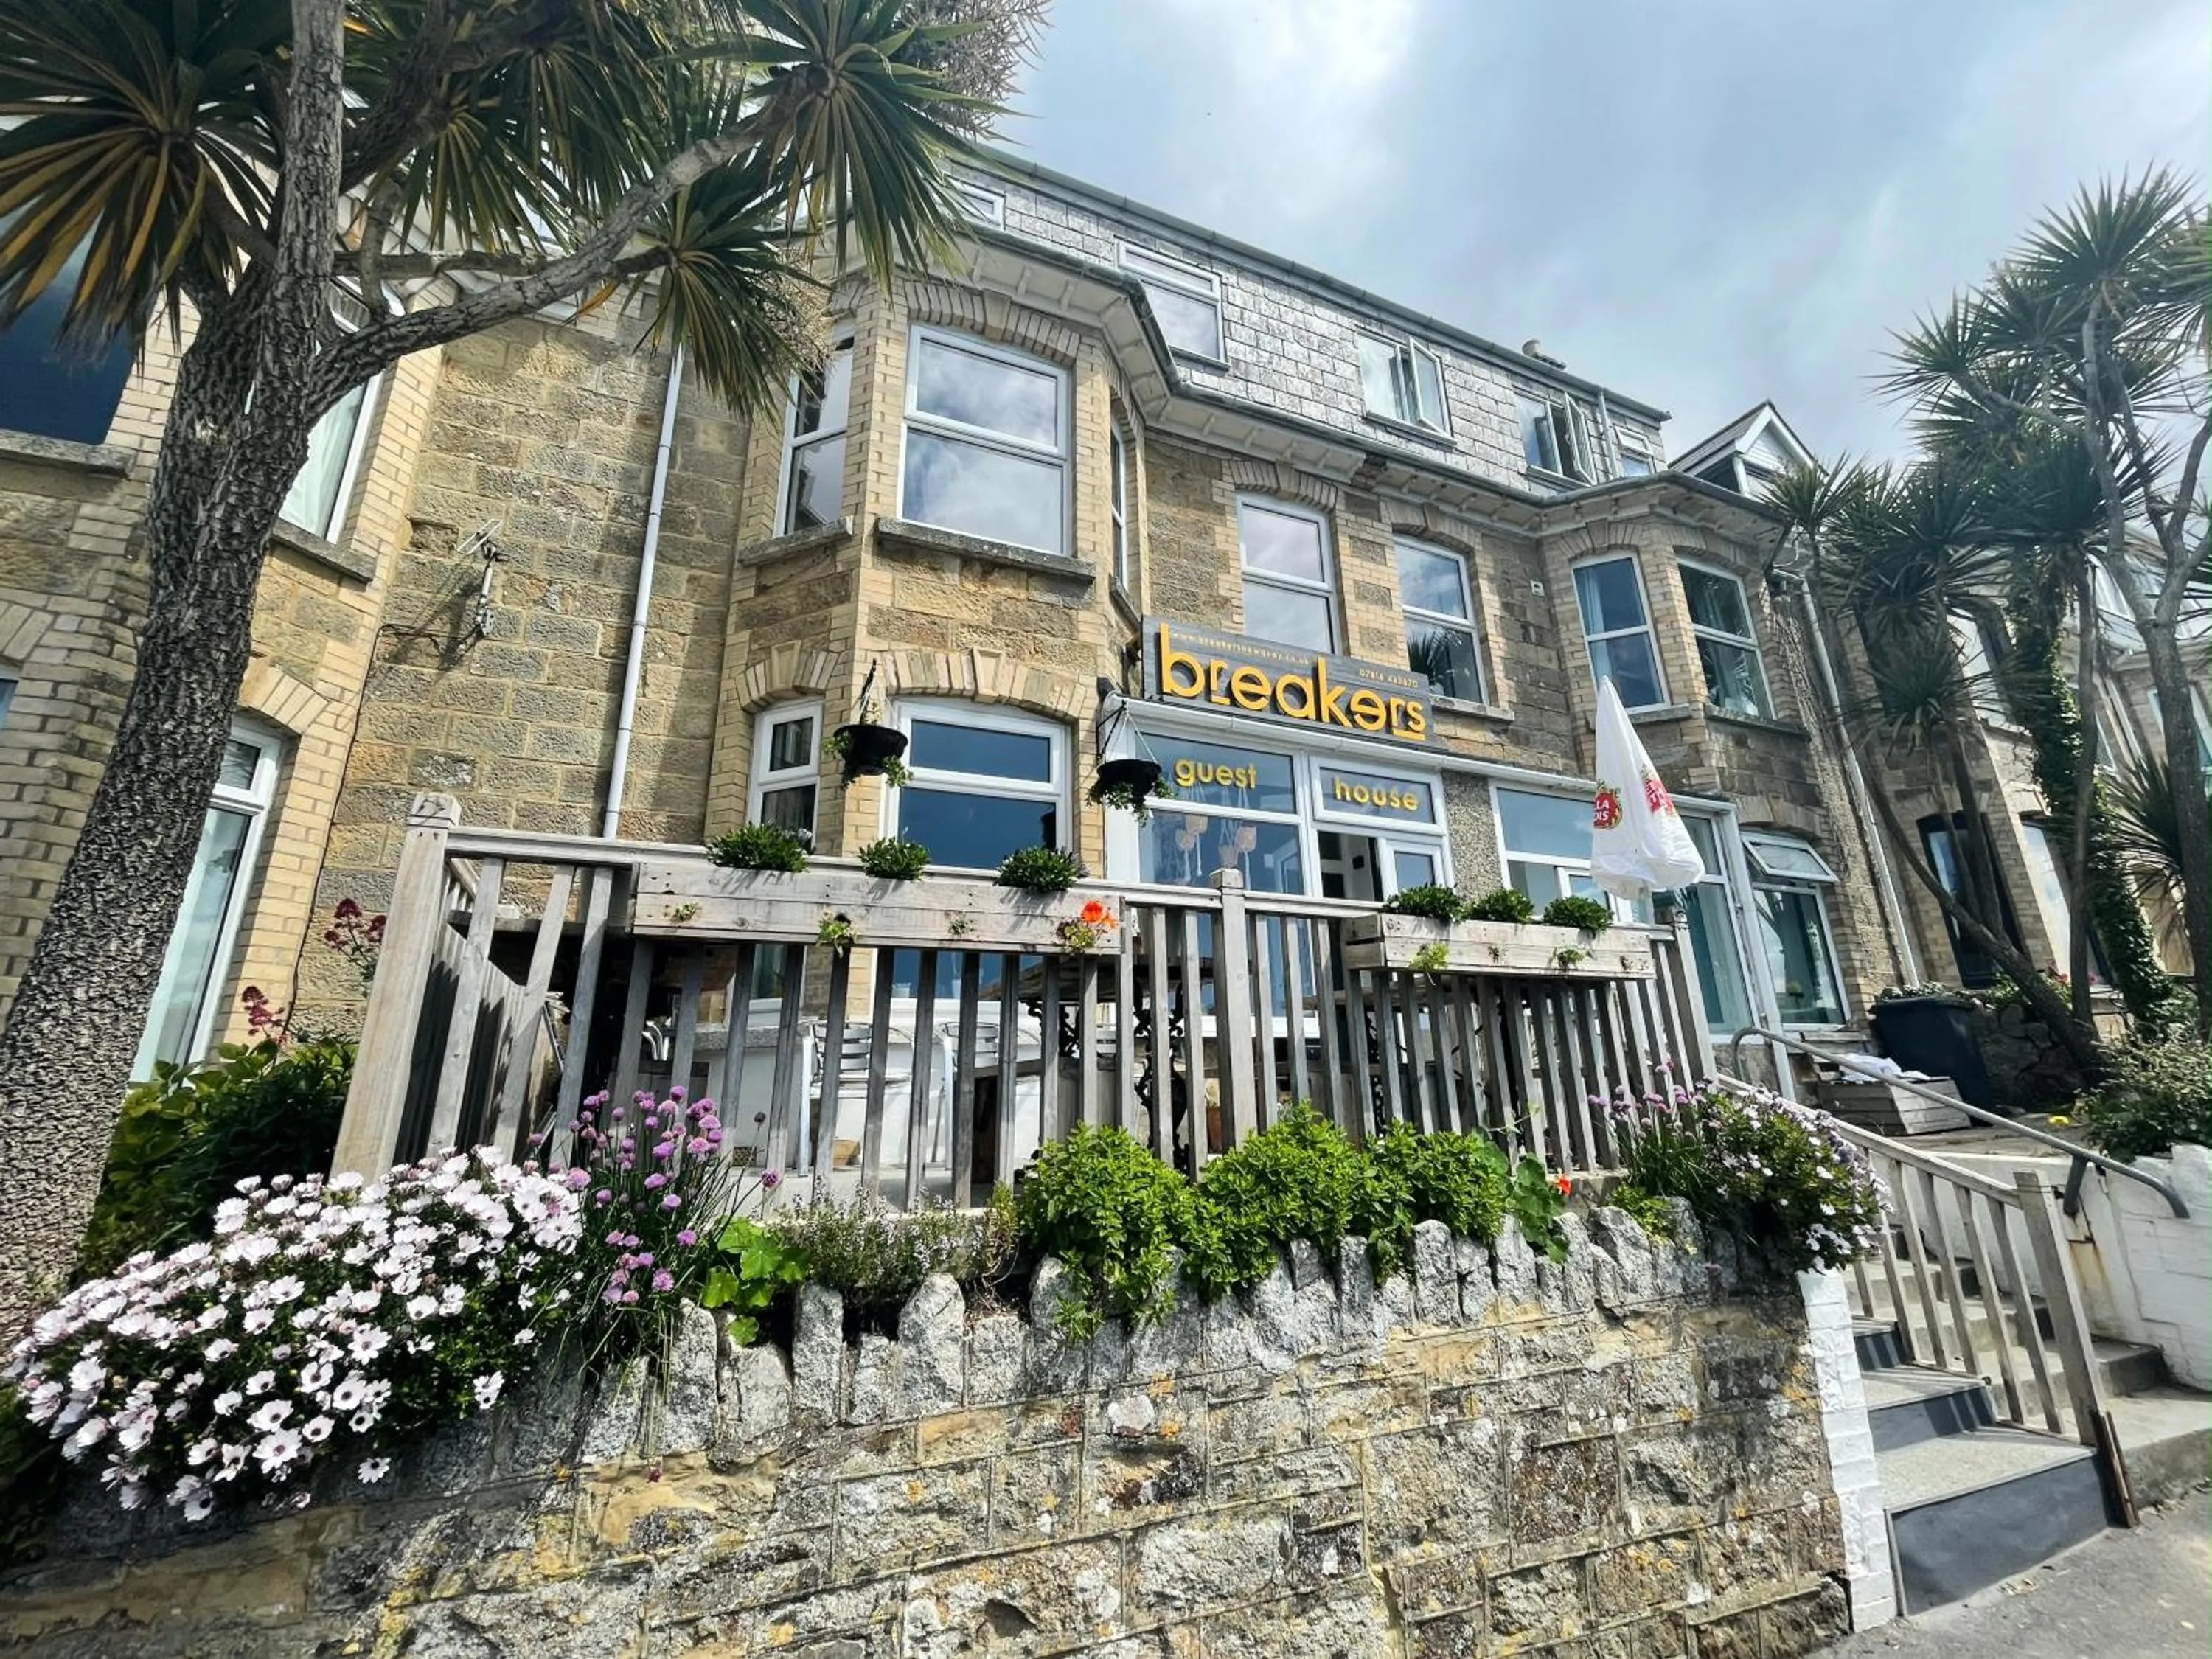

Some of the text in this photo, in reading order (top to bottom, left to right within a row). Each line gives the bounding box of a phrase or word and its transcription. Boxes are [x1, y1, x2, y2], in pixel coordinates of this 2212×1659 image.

[1160, 622, 1426, 741] breakers
[1175, 759, 1257, 789] guest
[1335, 778, 1419, 810] house
